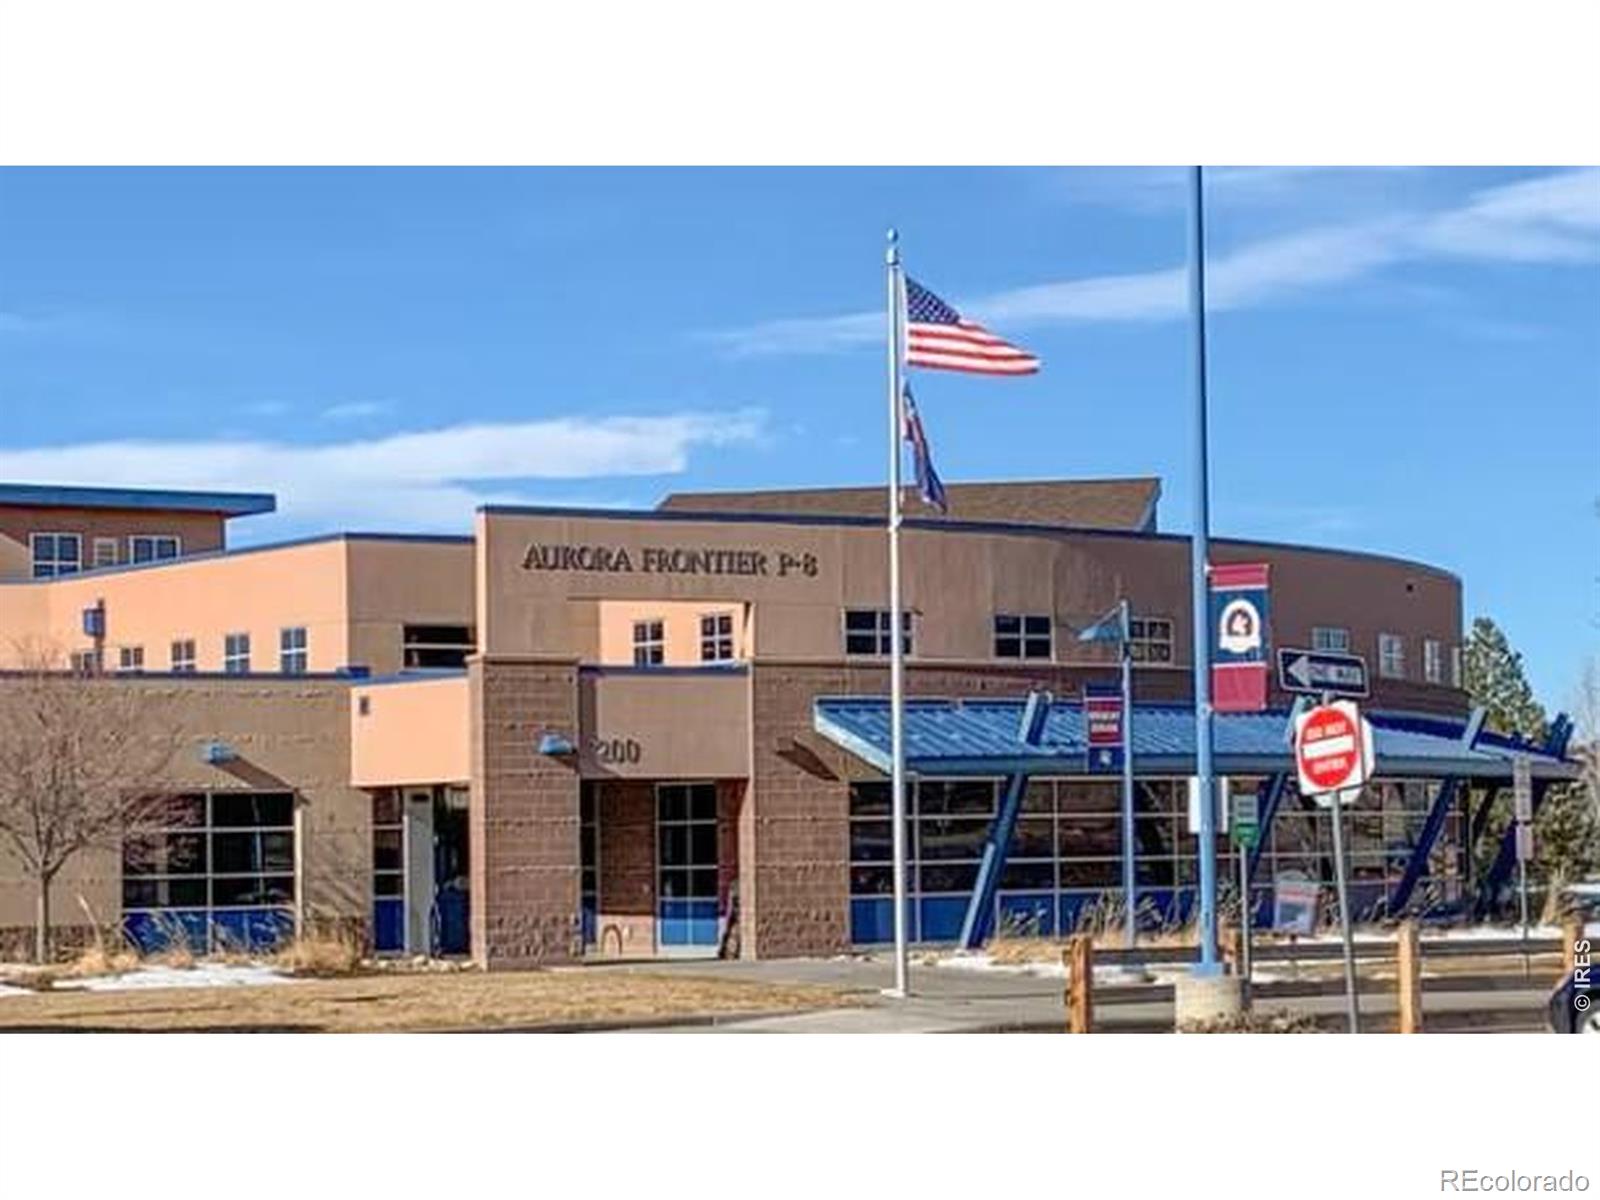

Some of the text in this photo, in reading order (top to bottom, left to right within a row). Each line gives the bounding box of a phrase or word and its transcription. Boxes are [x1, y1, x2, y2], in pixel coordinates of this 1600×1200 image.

[522, 545, 819, 577] AURORA FRONTIER P-8
